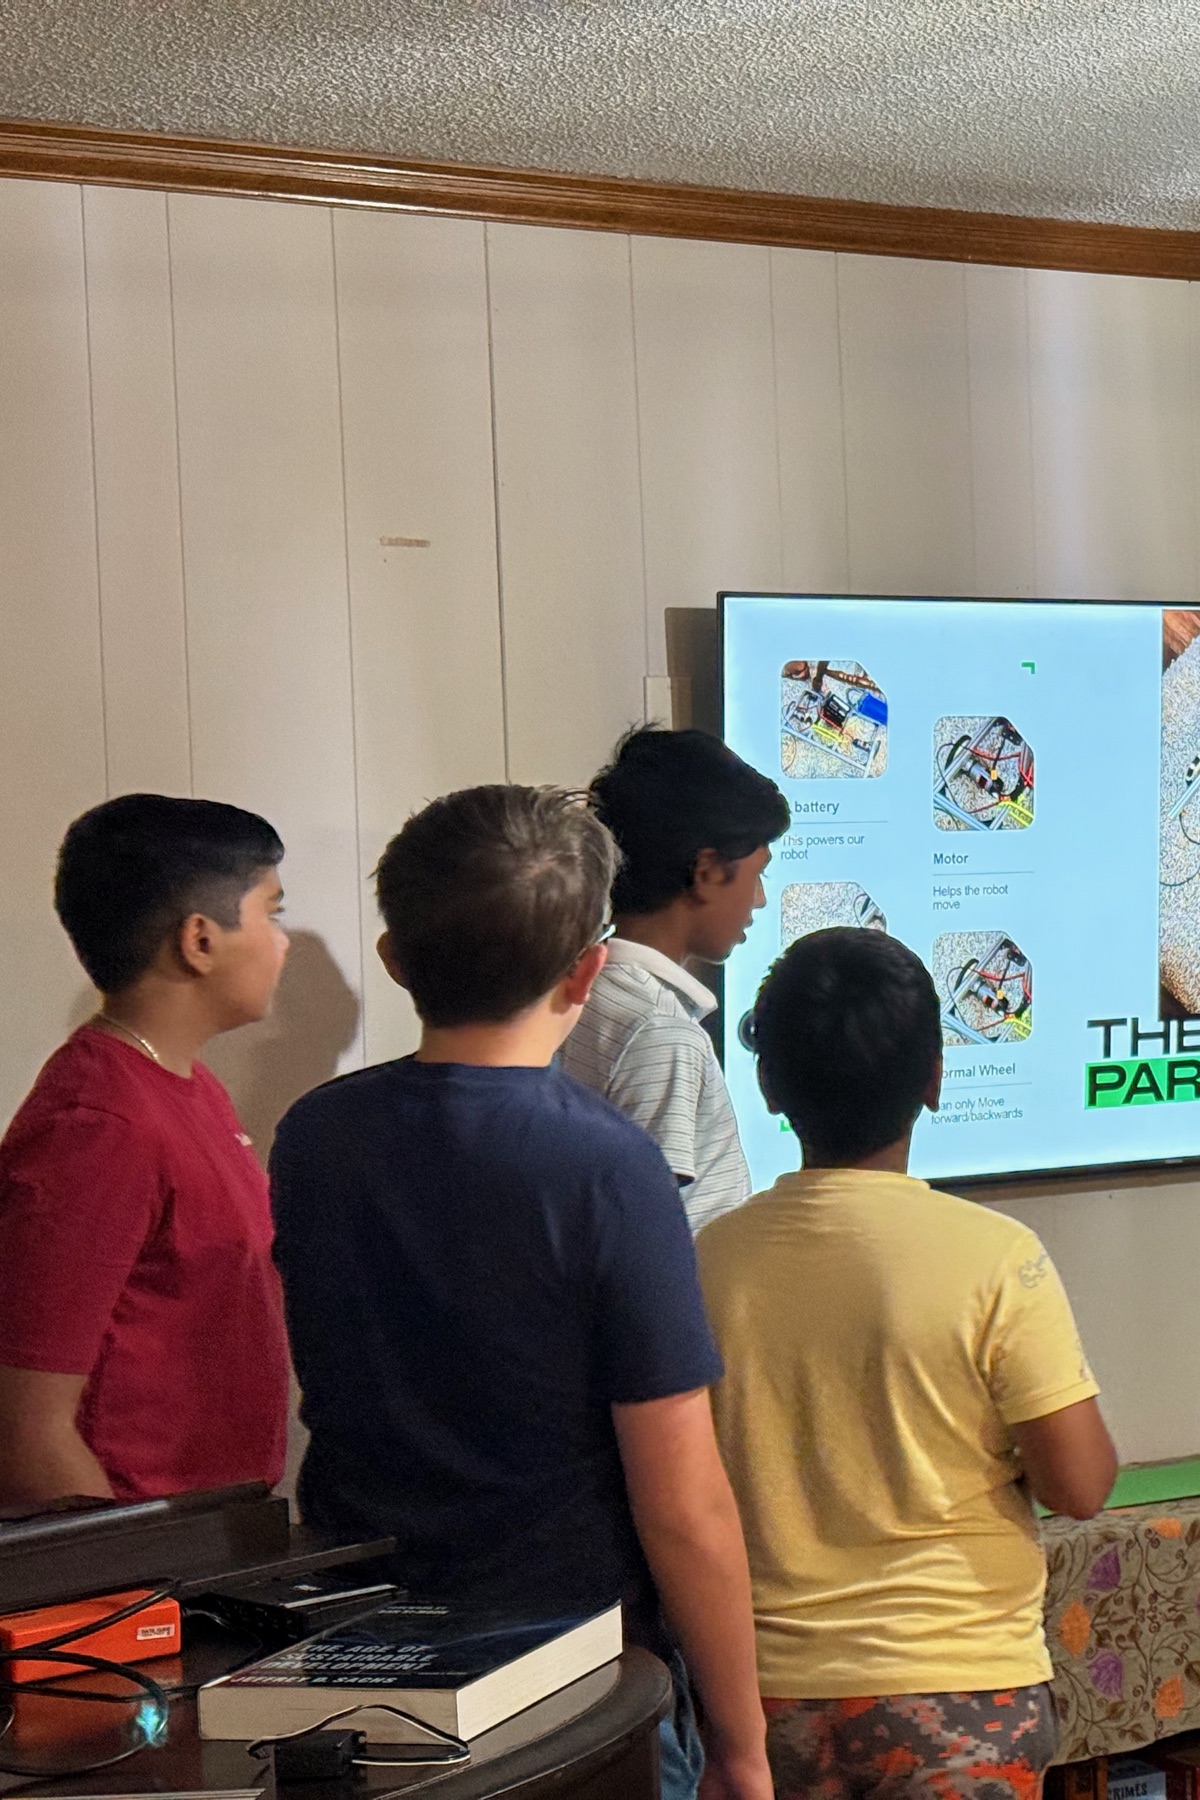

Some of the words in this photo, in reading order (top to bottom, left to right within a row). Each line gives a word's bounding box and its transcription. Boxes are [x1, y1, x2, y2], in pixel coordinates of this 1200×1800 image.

[794, 801, 840, 815] battery
[782, 834, 803, 846] This
[806, 836, 845, 848] powers
[847, 835, 865, 845] our
[780, 849, 809, 860] robot
[933, 853, 969, 864] Motor
[932, 886, 962, 898] Helps
[964, 885, 980, 895] the
[982, 884, 1009, 895] robot
[932, 901, 960, 910] move
[941, 1065, 976, 1079] ormal
[979, 1063, 1016, 1076] Wheel
[940, 1101, 952, 1111] an
[954, 1098, 976, 1112] only
[978, 1097, 1005, 1107] Move
[931, 1107, 1023, 1124] forward/backwards
[301, 1644, 344, 1653] THE
[344, 1645, 396, 1653] AGE
[396, 1645, 433, 1653] OF
[279, 1653, 440, 1662] SUSTAINABLE
[260, 1661, 432, 1670] DEVELOPMENT
